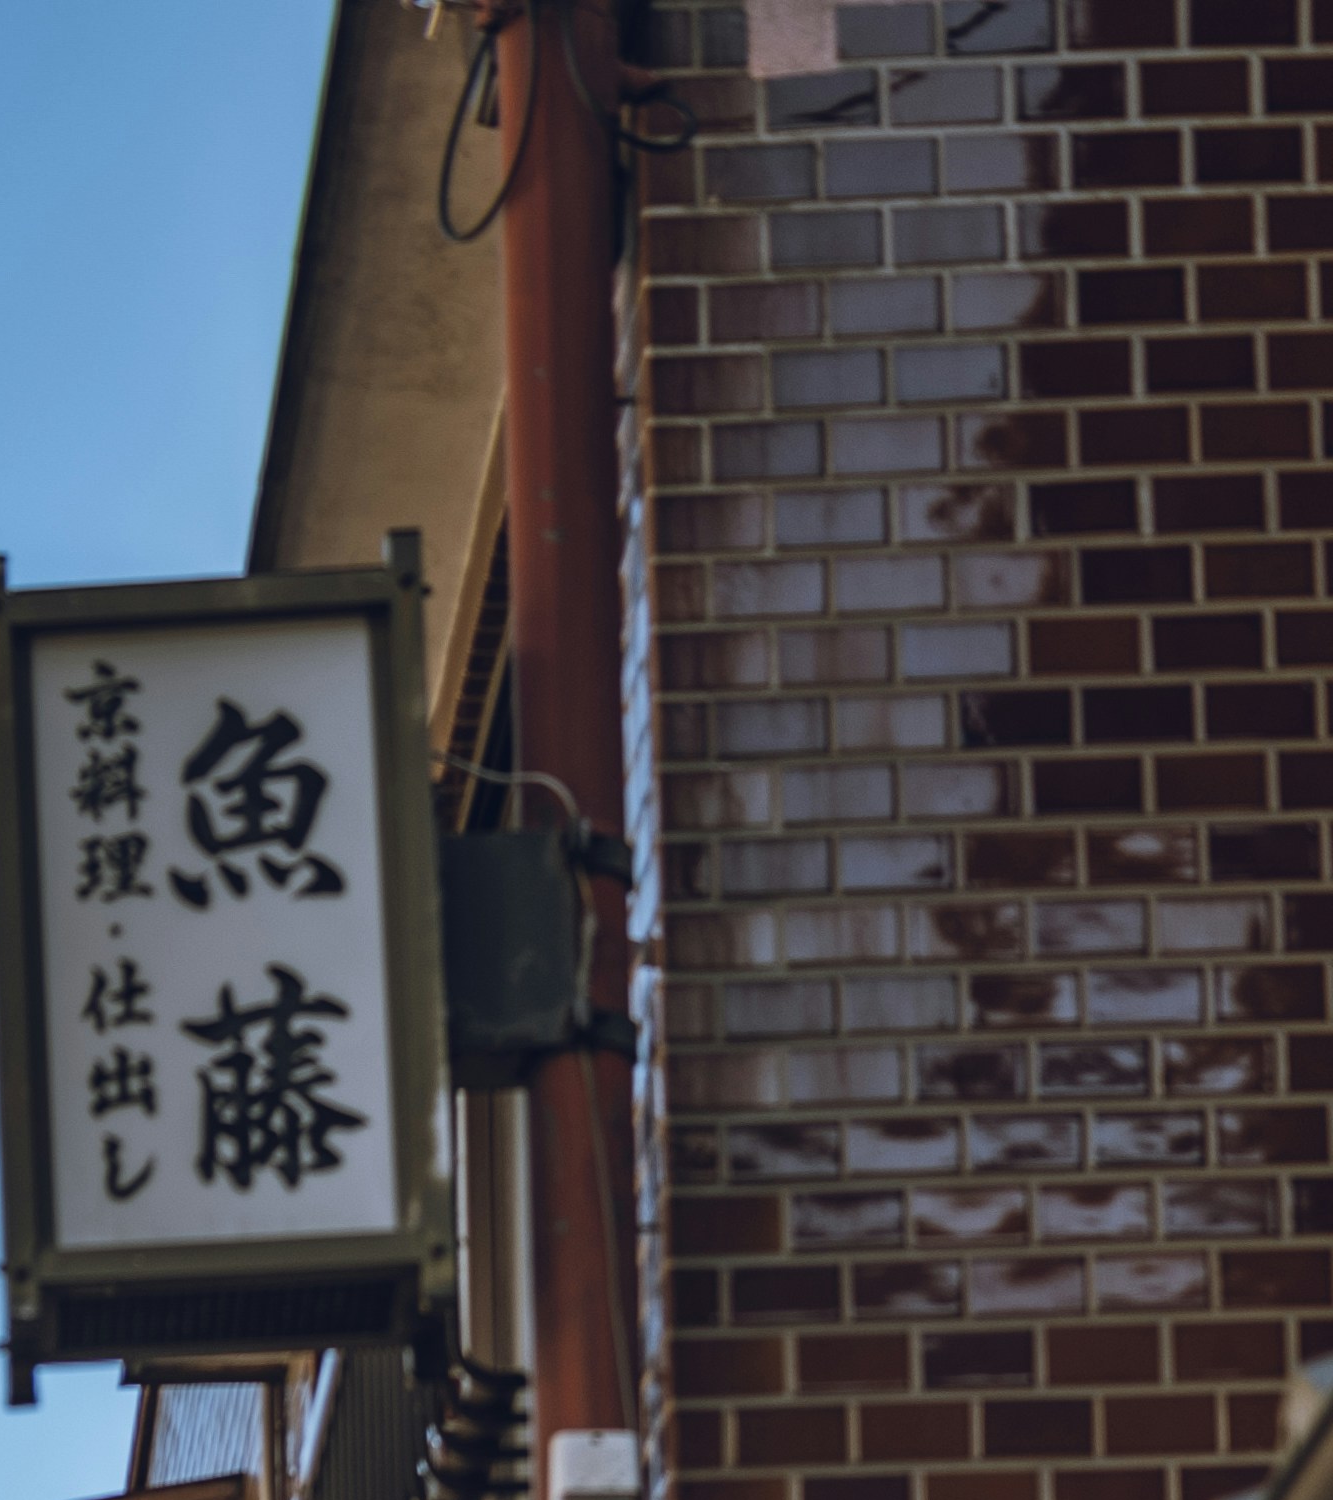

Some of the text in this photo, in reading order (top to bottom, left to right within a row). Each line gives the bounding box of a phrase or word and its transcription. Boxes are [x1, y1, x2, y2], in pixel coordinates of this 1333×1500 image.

[64, 661, 156, 1200] 京料理・仕出し
[166, 698, 369, 1192] 魚藤
